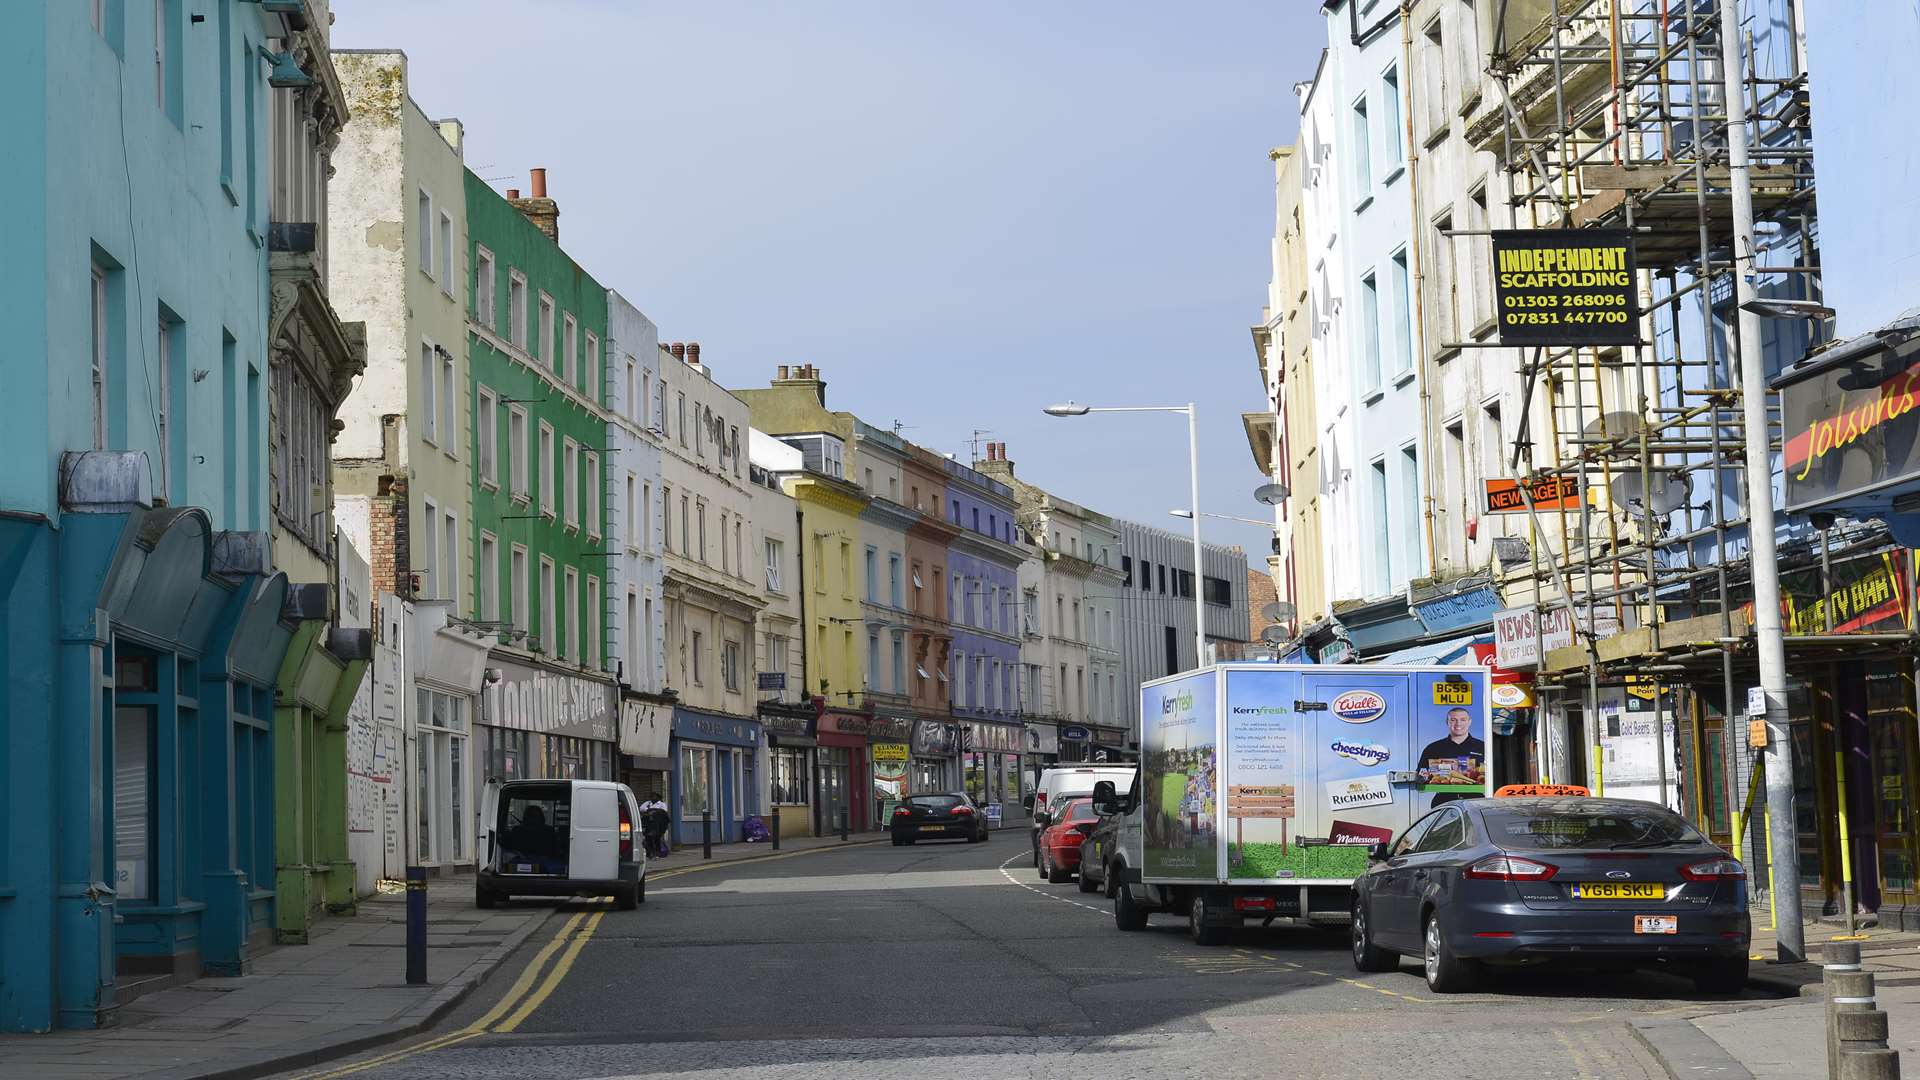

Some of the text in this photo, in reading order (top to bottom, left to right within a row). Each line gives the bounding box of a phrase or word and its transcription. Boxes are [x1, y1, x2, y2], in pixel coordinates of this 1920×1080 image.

[1499, 247, 1627, 272] INDEPENDENT
[1501, 271, 1630, 288] SCAFFOLDING
[1505, 294, 1626, 307] 01303 268096
[1506, 311, 1628, 325] 07831 447700
[1436, 683, 1468, 693] BG59
[1440, 694, 1465, 704] MLU
[1233, 705, 1287, 716] Kerryfresh
[1332, 790, 1387, 806] RICHMOND
[1335, 833, 1380, 844] Mattessons
[1582, 884, 1654, 897] YG61 SKU
